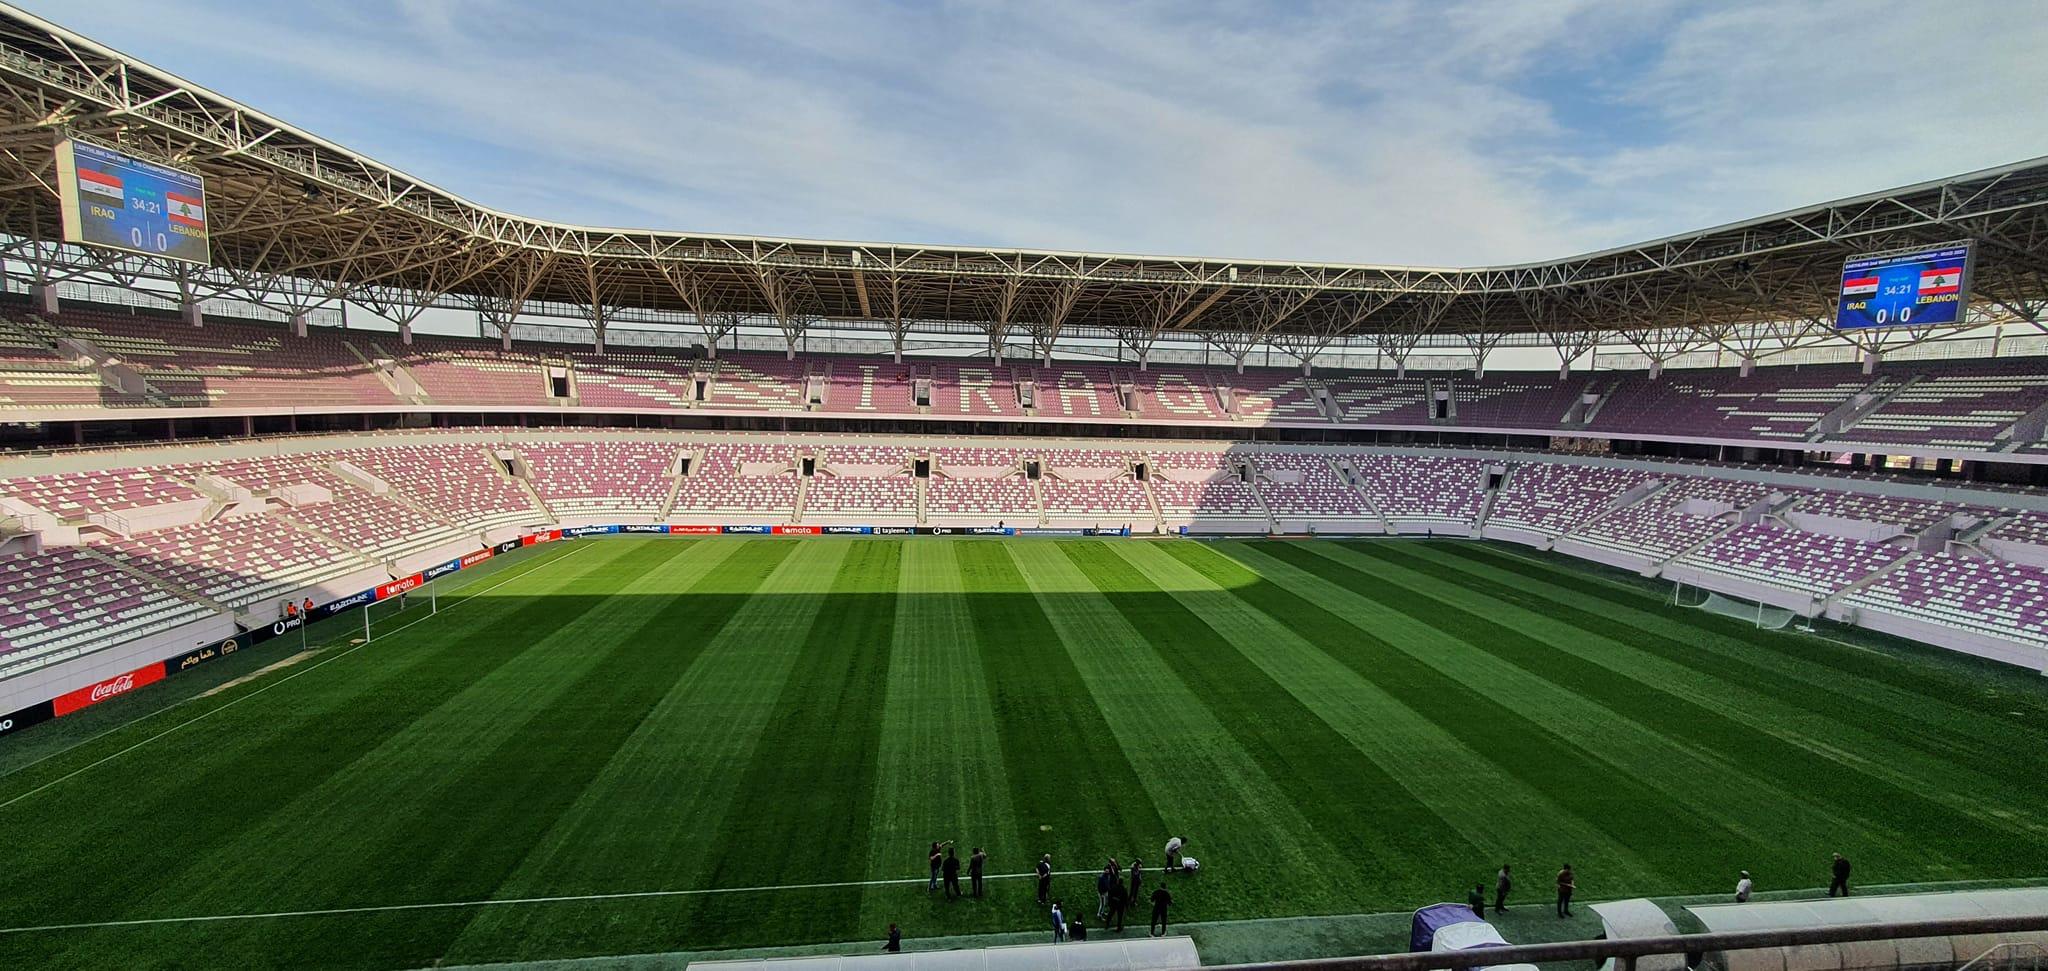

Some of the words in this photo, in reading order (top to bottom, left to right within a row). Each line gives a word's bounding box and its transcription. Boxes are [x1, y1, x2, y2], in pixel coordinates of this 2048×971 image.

[91, 206, 115, 220] IRAQ
[132, 198, 160, 214] 34:21
[132, 228, 142, 247] 0
[157, 233, 167, 251] 0
[169, 224, 206, 240] LEBANON
[1884, 284, 1911, 295] 34:21
[1847, 301, 1866, 310] IRAQ
[1916, 294, 1958, 304] LEBANON
[1876, 309, 1887, 323] 0
[1900, 307, 1911, 322] 0
[855, 365, 1216, 417] IRAQ
[286, 618, 300, 629] PRO
